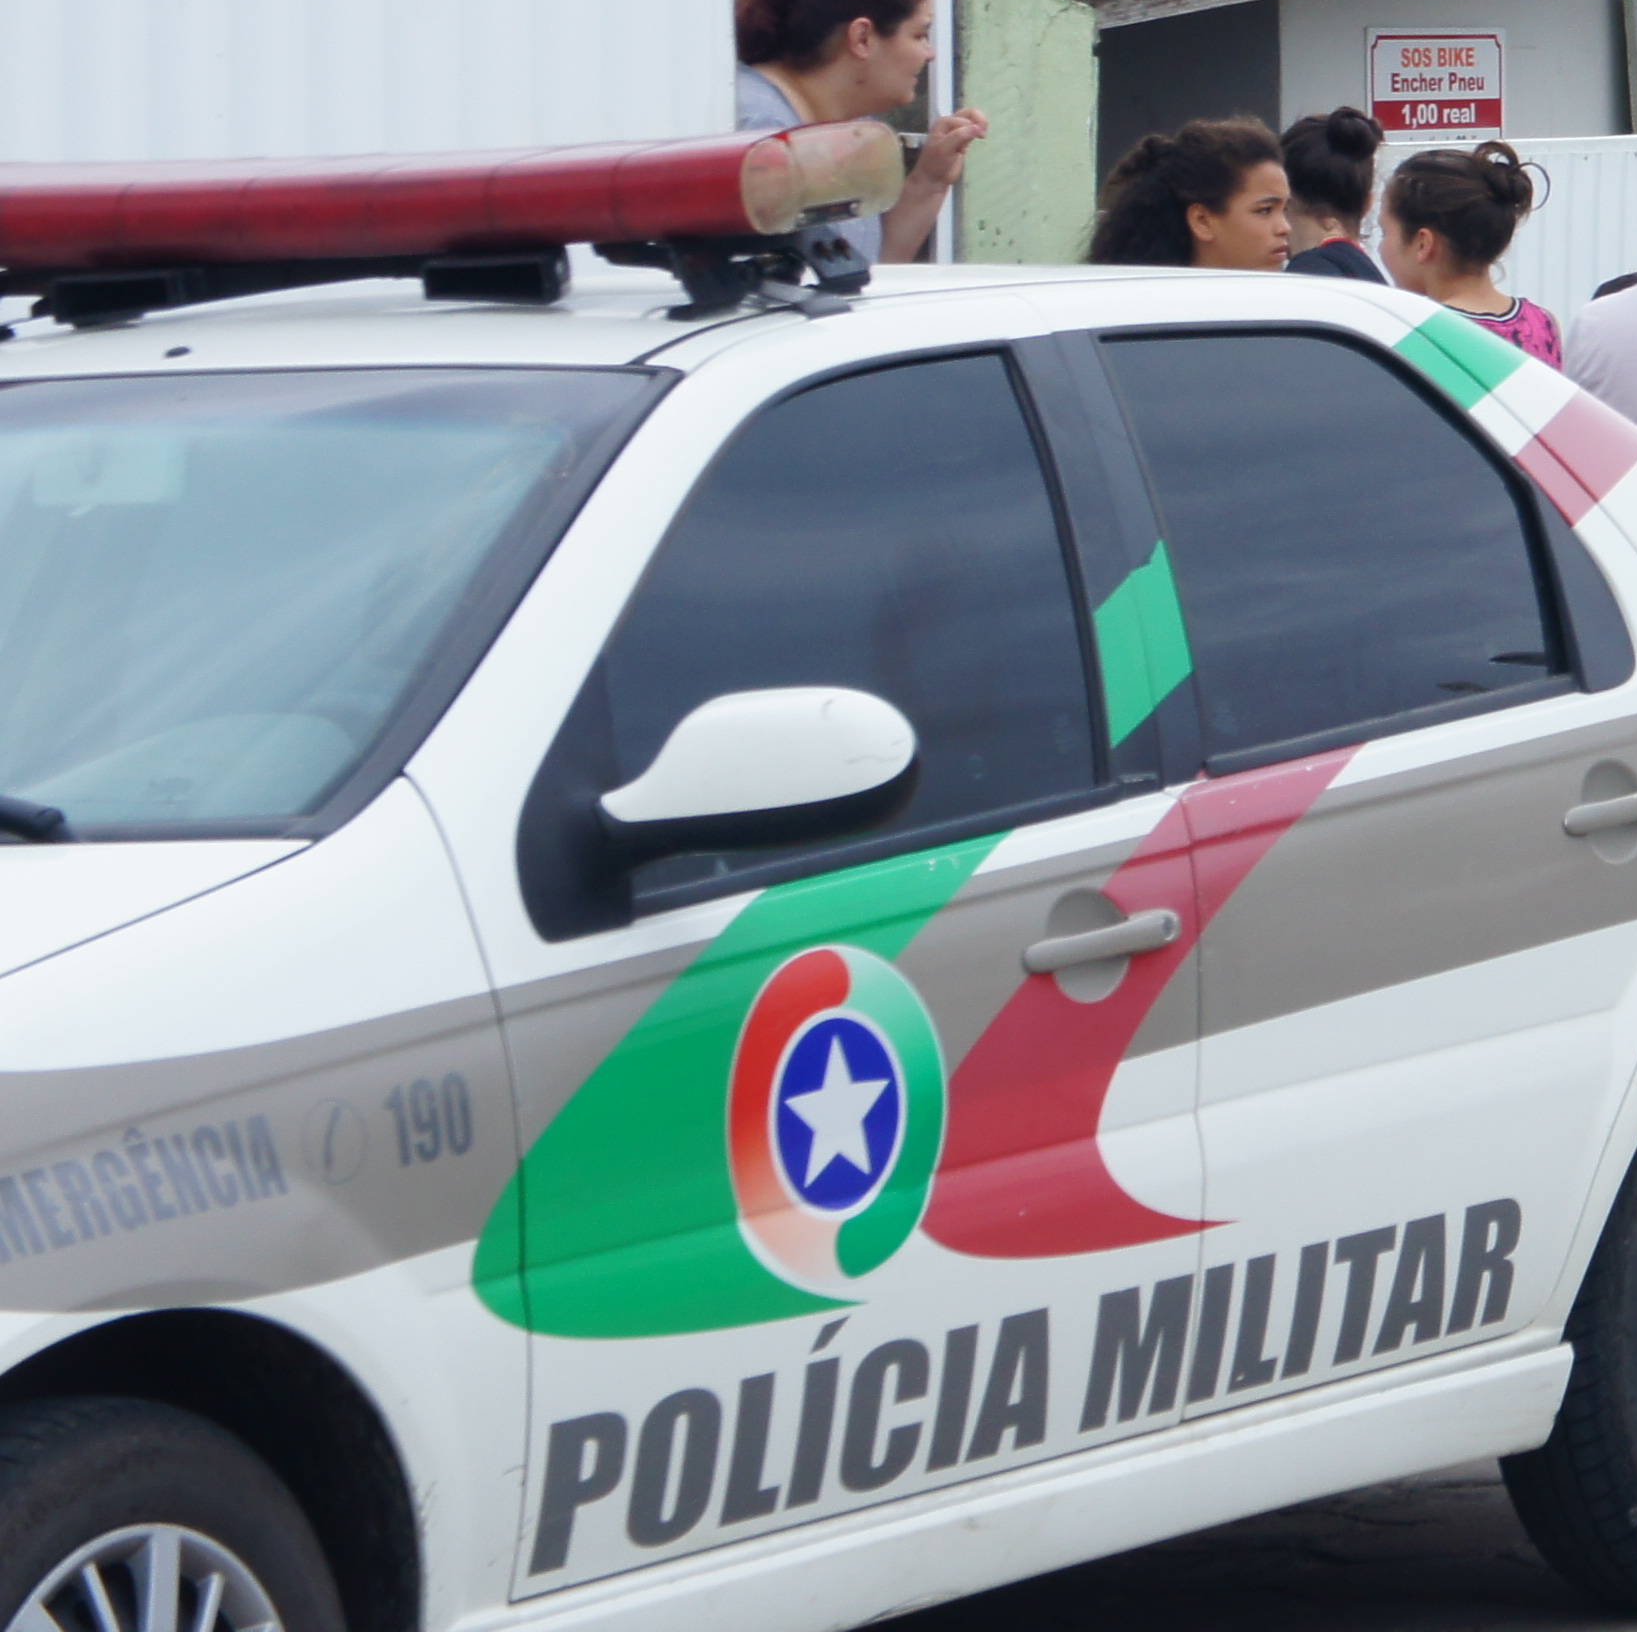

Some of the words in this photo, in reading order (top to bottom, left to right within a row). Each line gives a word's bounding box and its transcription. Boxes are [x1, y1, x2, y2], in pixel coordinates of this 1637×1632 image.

[1401, 47, 1432, 68] SOS
[1437, 47, 1475, 67] BIKE
[1391, 72, 1444, 92] Encher
[1448, 72, 1485, 92] Pneu
[1401, 103, 1438, 128] 1,00
[1443, 103, 1475, 123] real
[0, 1113, 290, 1264] MERGÊNCIA
[384, 1071, 476, 1168] 190
[528, 1307, 1051, 1578] POLÍCIA
[1078, 1197, 1523, 1434] MILITAR
